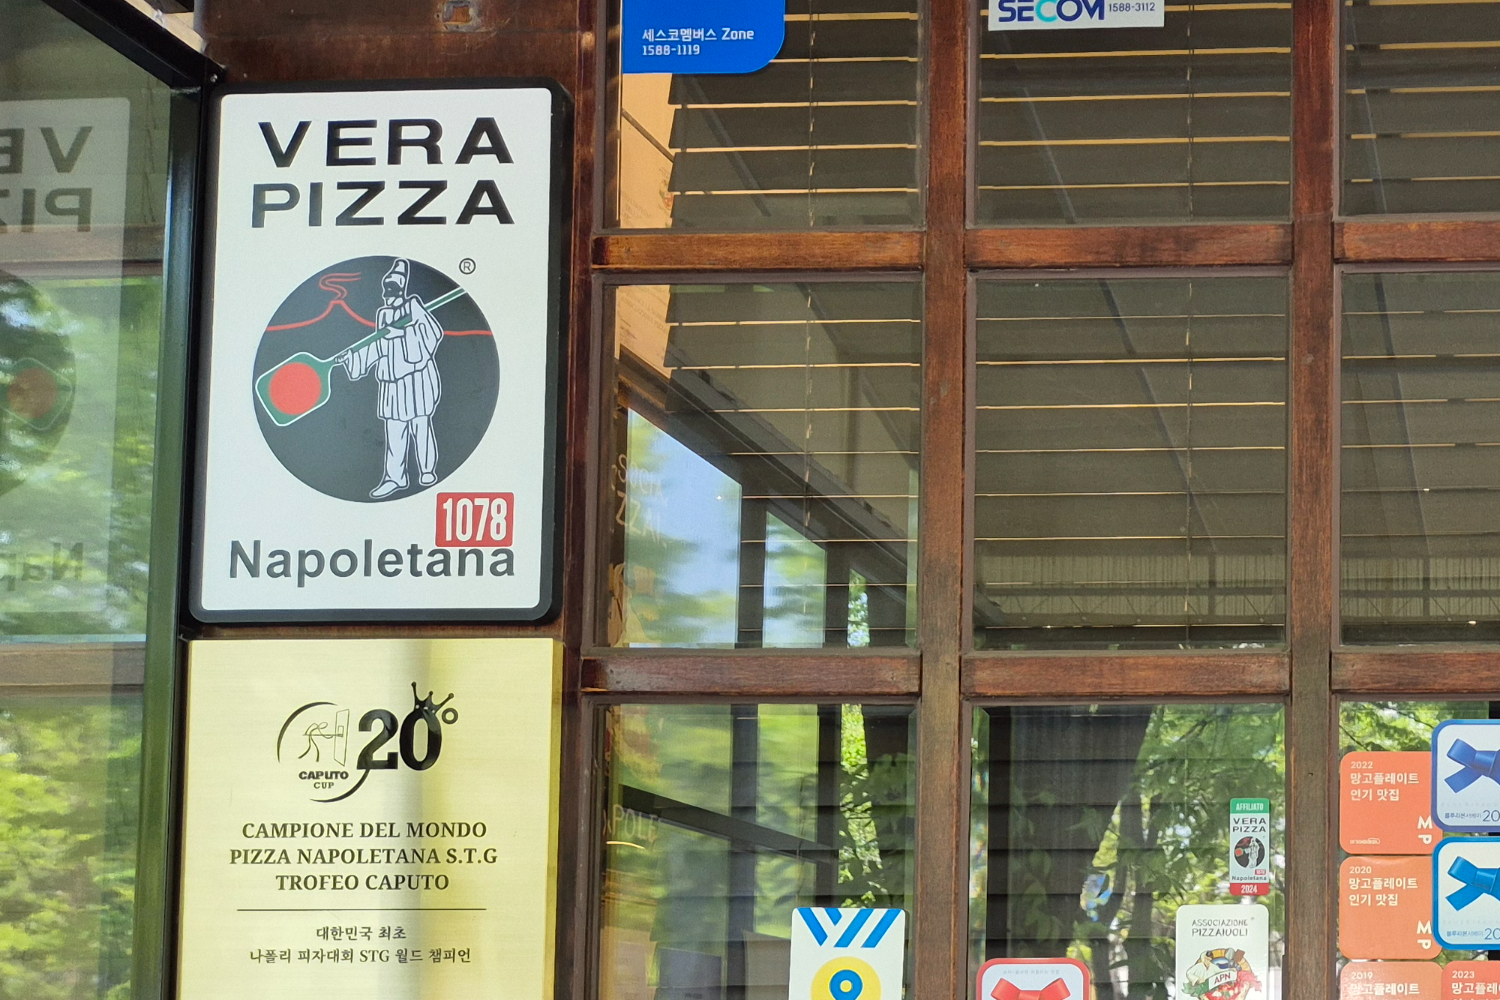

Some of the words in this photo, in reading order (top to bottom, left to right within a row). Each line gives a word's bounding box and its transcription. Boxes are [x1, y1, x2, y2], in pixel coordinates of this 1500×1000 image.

[999, 0, 1104, 22] SECOM
[1109, 2, 1155, 12] 1588-3112
[722, 28, 754, 40] Zone
[643, 45, 699, 55] 1588-1119
[258, 118, 513, 167] VERA
[252, 180, 514, 228] PIZZA
[441, 498, 508, 542] 1078
[230, 536, 514, 587] Napoletana
[1351, 761, 1373, 769] 2022
[299, 771, 349, 779] CAPUTO
[1351, 773, 1419, 784] 망고플레이트
[1351, 789, 1372, 801] 인기
[1377, 789, 1399, 801] 맛집
[243, 823, 353, 838] CAMPIONE
[360, 823, 400, 837] DEL
[407, 823, 486, 837] MONDO
[230, 849, 291, 864] PIZZA
[298, 848, 441, 864] NAPOLETANA
[446, 848, 497, 863] S.T.G
[276, 875, 358, 890] TROFEO
[366, 875, 448, 890] CAPUTO
[1349, 877, 1418, 890] 망고플레이트
[1241, 885, 1257, 893] 2024
[1349, 894, 1371, 906] 인기
[1376, 894, 1397, 906] 맛집
[317, 926, 373, 941] 대한민국
[379, 926, 406, 940] 최초
[1192, 928, 1247, 936] PIZZAIUOLI
[250, 949, 290, 963] 나폴리
[298, 948, 353, 963] 피자대회
[360, 950, 389, 962] STG
[396, 948, 423, 963] 월드
[429, 948, 470, 963] 챔피언
[1214, 972, 1231, 984] APN
[1351, 971, 1374, 979] 2019
